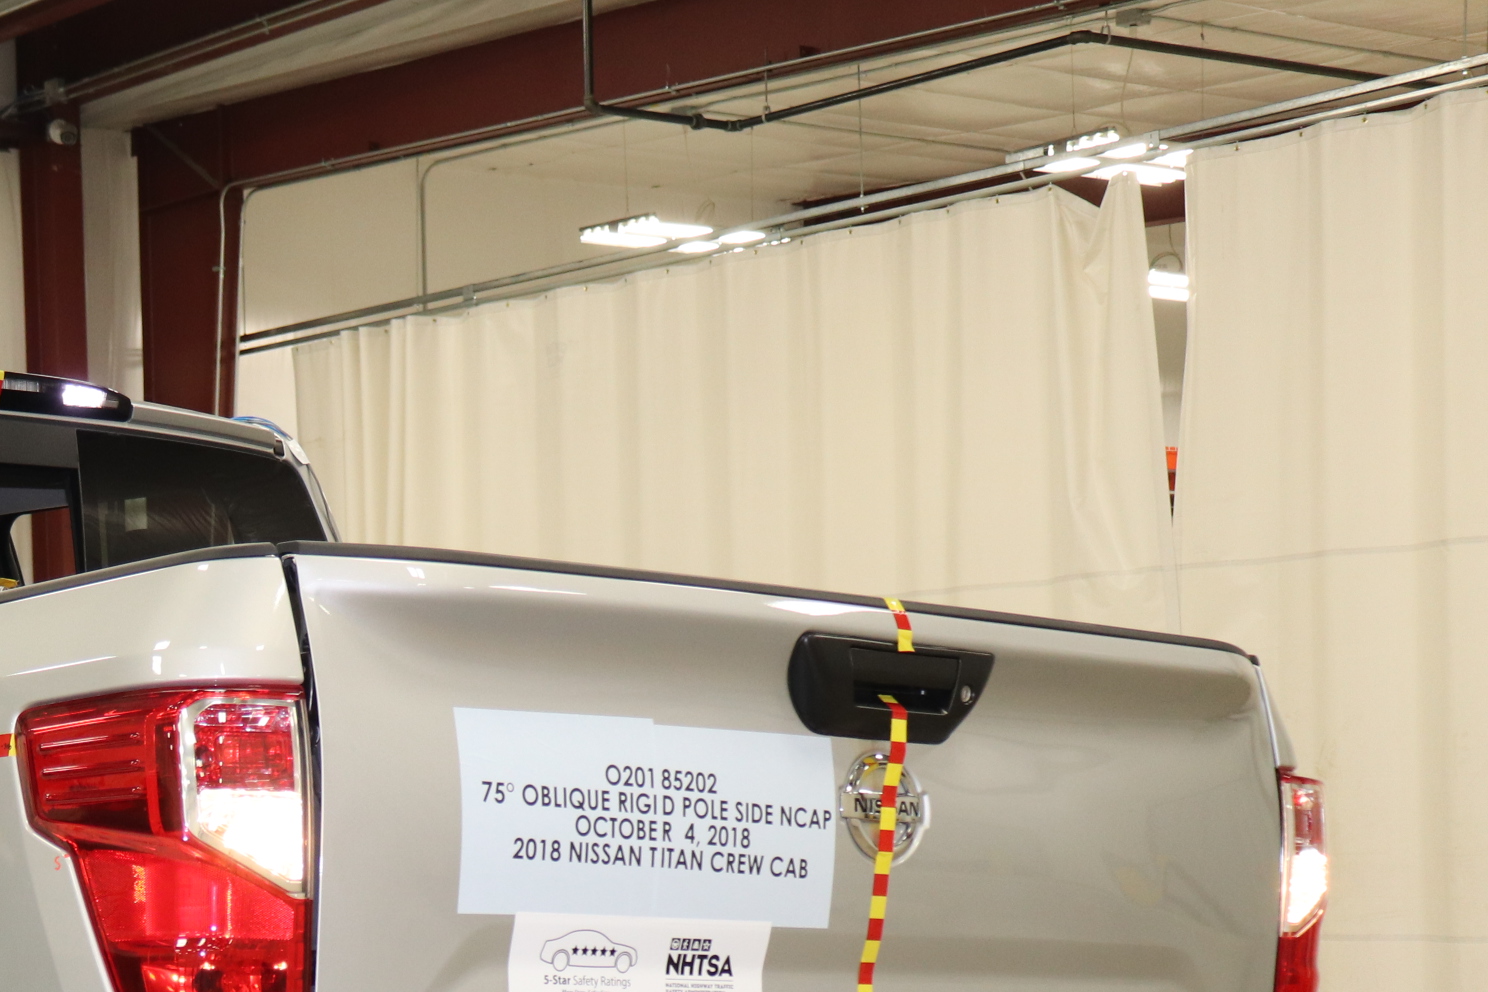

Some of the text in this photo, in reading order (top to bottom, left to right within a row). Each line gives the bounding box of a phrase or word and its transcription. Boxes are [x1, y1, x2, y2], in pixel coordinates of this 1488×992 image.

[522, 784, 611, 812] OBLIQUE
[618, 791, 675, 816] RIGID
[682, 797, 729, 821] POLE
[735, 801, 774, 825] SIDE
[780, 806, 832, 830] NCAP
[854, 797, 920, 817] NISAN
[575, 815, 751, 849] OCTOBER 4, 2018
[512, 837, 809, 879] 2018 NISSAN TITAN CREW CAB
[665, 953, 734, 977] NHTSA
[543, 974, 632, 989] 5-Star Safety Ratings
